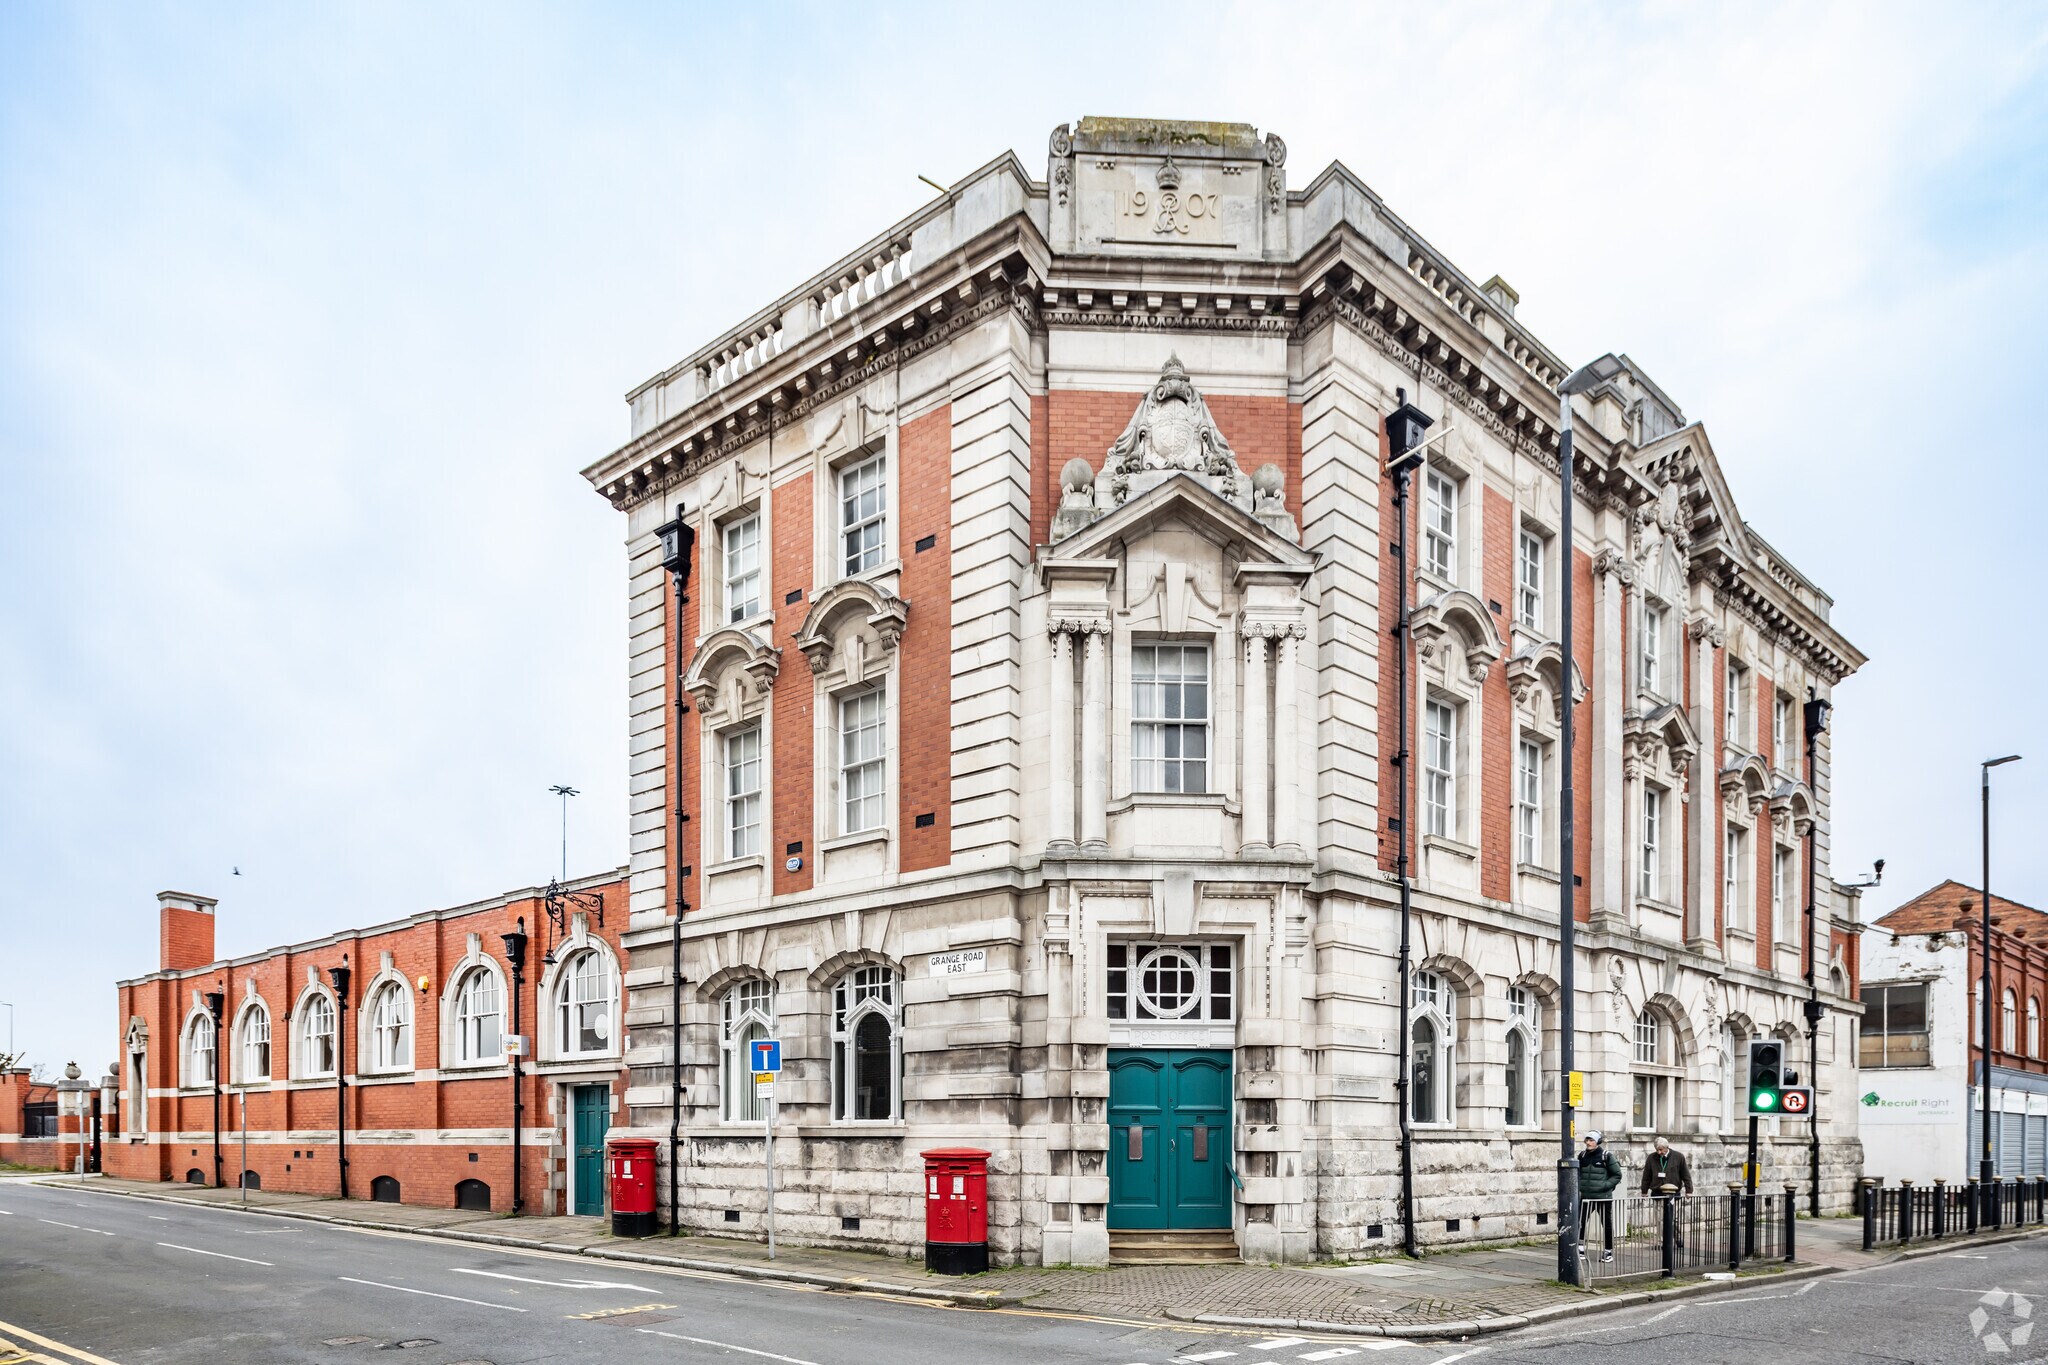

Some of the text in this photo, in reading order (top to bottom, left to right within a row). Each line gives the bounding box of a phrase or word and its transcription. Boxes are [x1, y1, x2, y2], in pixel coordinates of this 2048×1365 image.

[931, 951, 984, 966] GRANGE ROAD
[947, 963, 967, 974] EAST
[1134, 1030, 1162, 1041] POST
[1880, 1098, 1949, 1109] Recruit Right
